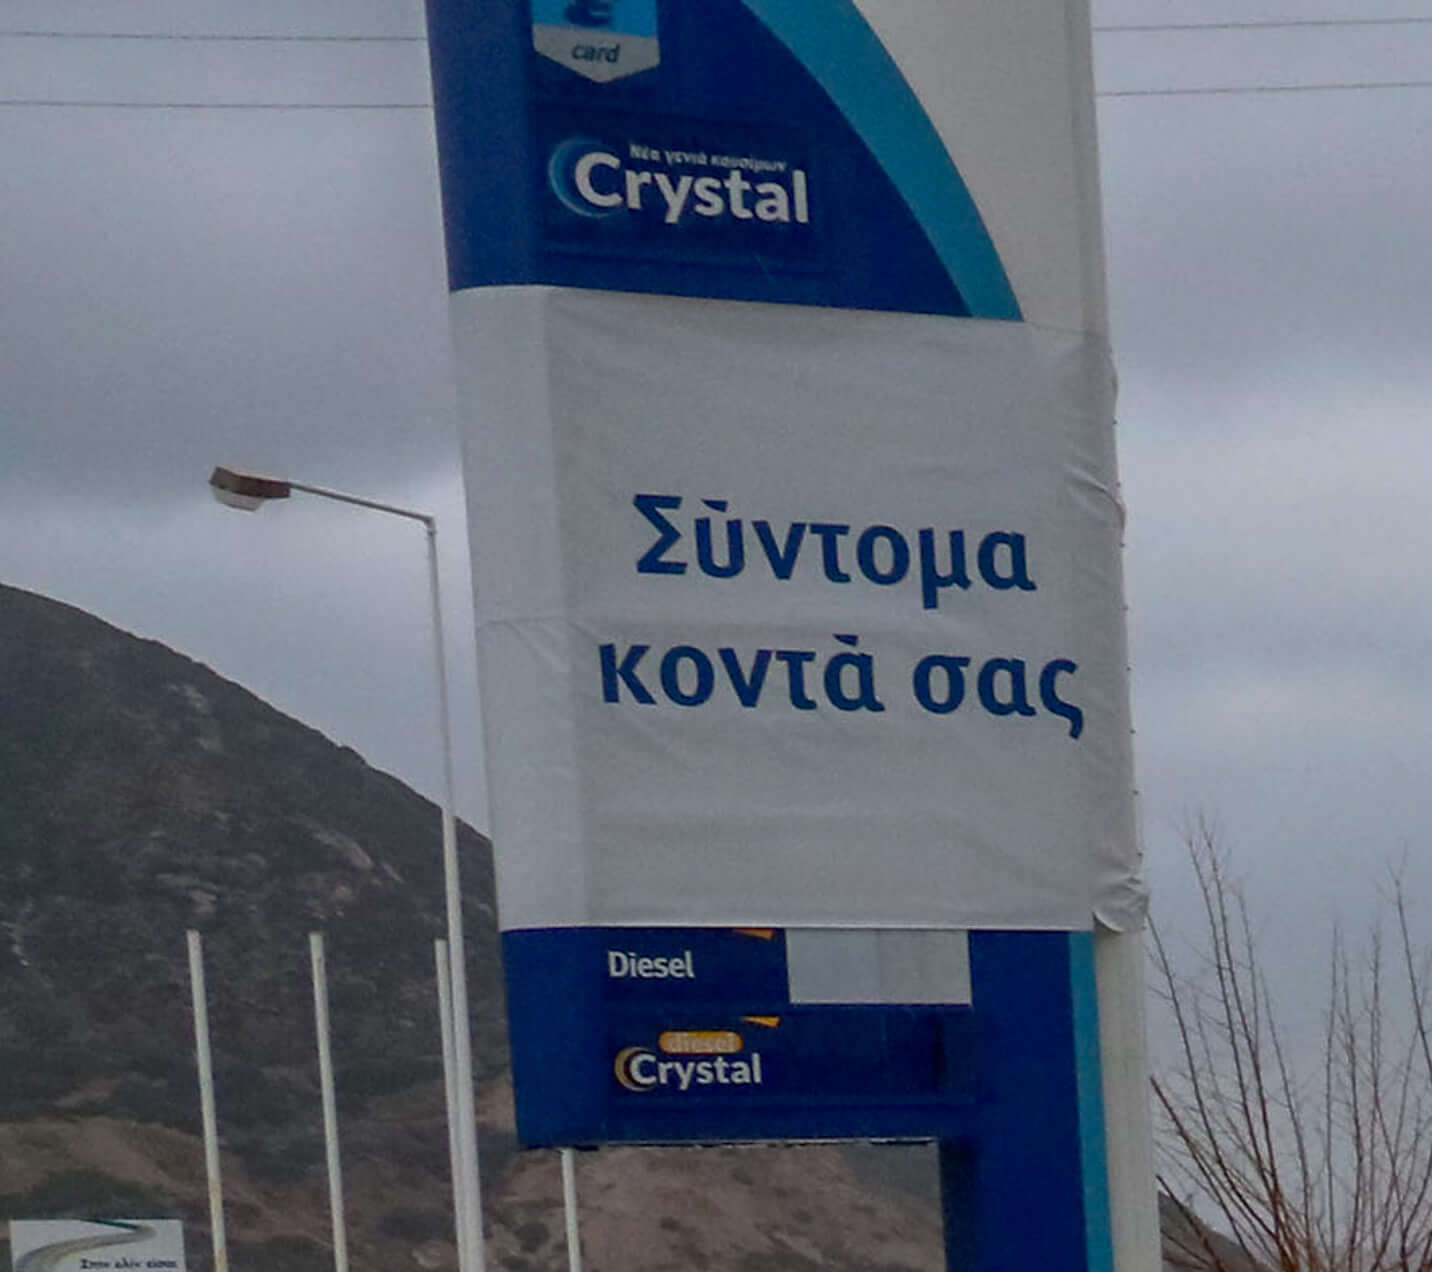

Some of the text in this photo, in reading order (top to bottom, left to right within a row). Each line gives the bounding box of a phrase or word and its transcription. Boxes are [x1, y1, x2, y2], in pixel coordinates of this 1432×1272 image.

[571, 43, 621, 63] card
[629, 144, 660, 161] Νέα
[665, 149, 707, 166] γενιά
[574, 152, 809, 224] Crystal
[633, 494, 1038, 609] Σύντομα
[599, 633, 1085, 740] κοντά σας
[608, 950, 695, 979] Diesel
[629, 1052, 762, 1091] Crystal
